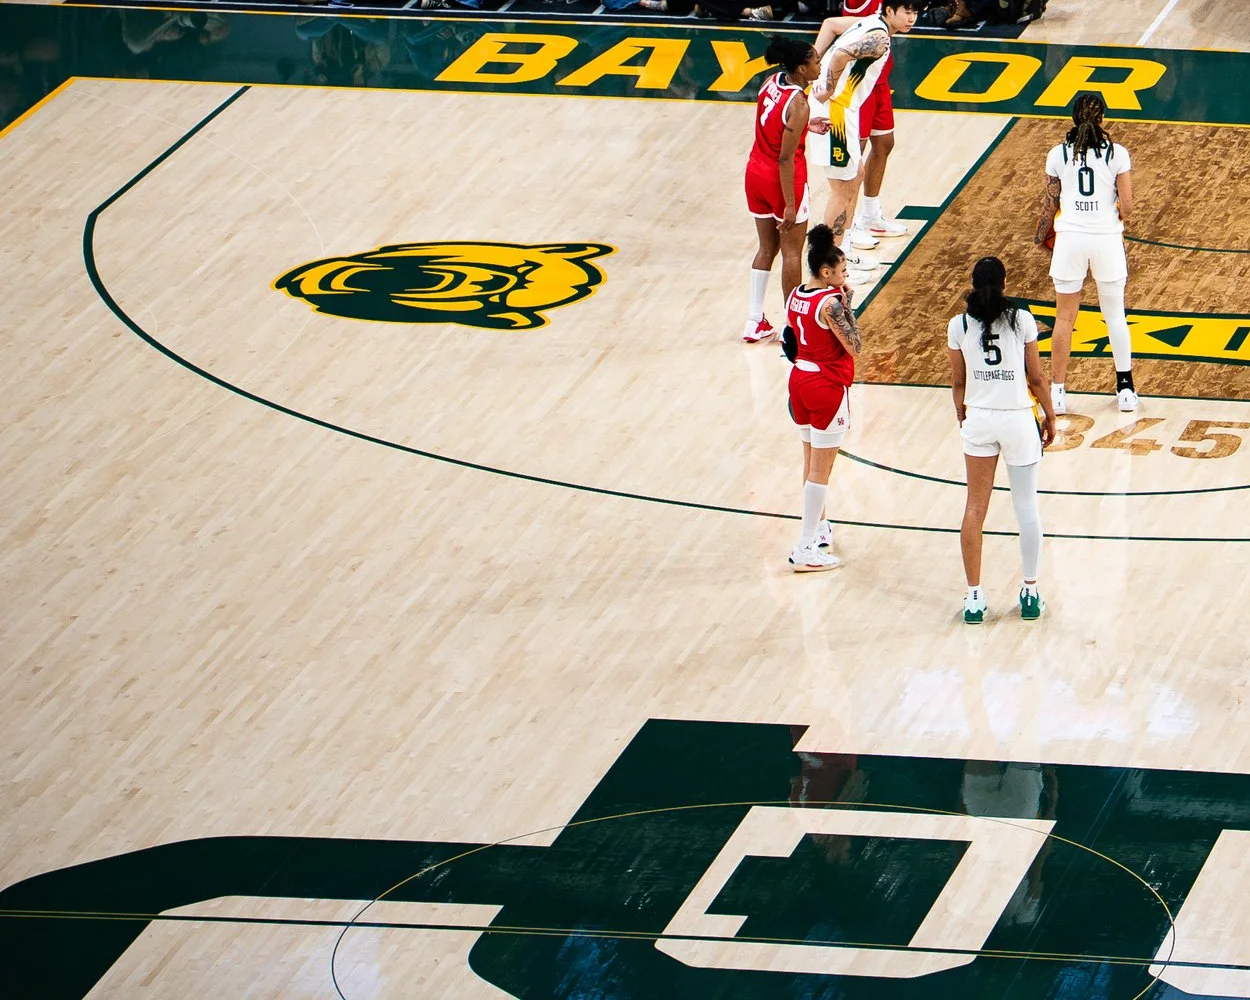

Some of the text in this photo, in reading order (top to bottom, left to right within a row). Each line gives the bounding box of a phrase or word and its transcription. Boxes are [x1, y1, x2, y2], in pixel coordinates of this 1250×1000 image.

[434, 32, 1167, 111] BAYOR
[760, 96, 776, 127] 7
[833, 147, 845, 162] BU
[1077, 166, 1095, 197] 0
[1075, 200, 1099, 212] SCOTT
[984, 333, 1003, 367] 5
